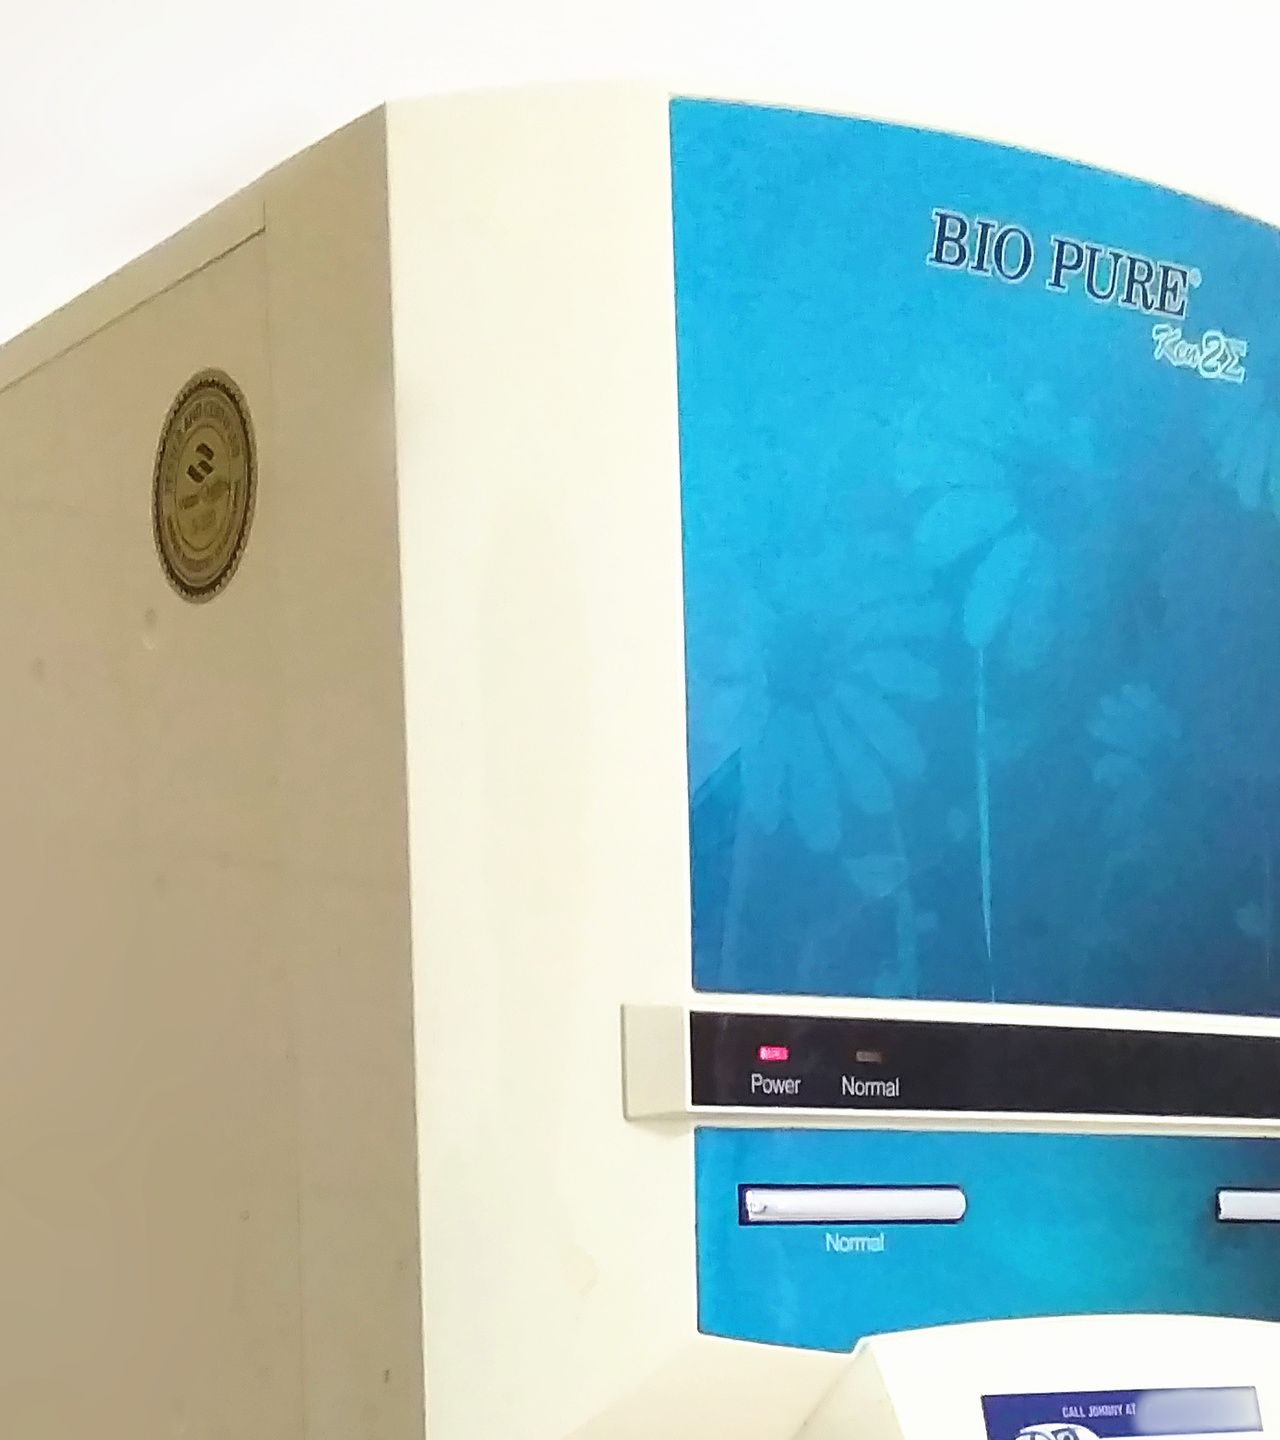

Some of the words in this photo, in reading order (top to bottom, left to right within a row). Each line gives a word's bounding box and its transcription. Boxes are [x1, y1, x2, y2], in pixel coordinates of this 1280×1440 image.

[927, 208, 1034, 284] BIO
[751, 1073, 801, 1094] Power
[841, 1075, 900, 1097] Normal
[825, 1232, 885, 1252] Normal
[1062, 1406, 1086, 1418] CALL
[1125, 1402, 1136, 1415] AT
